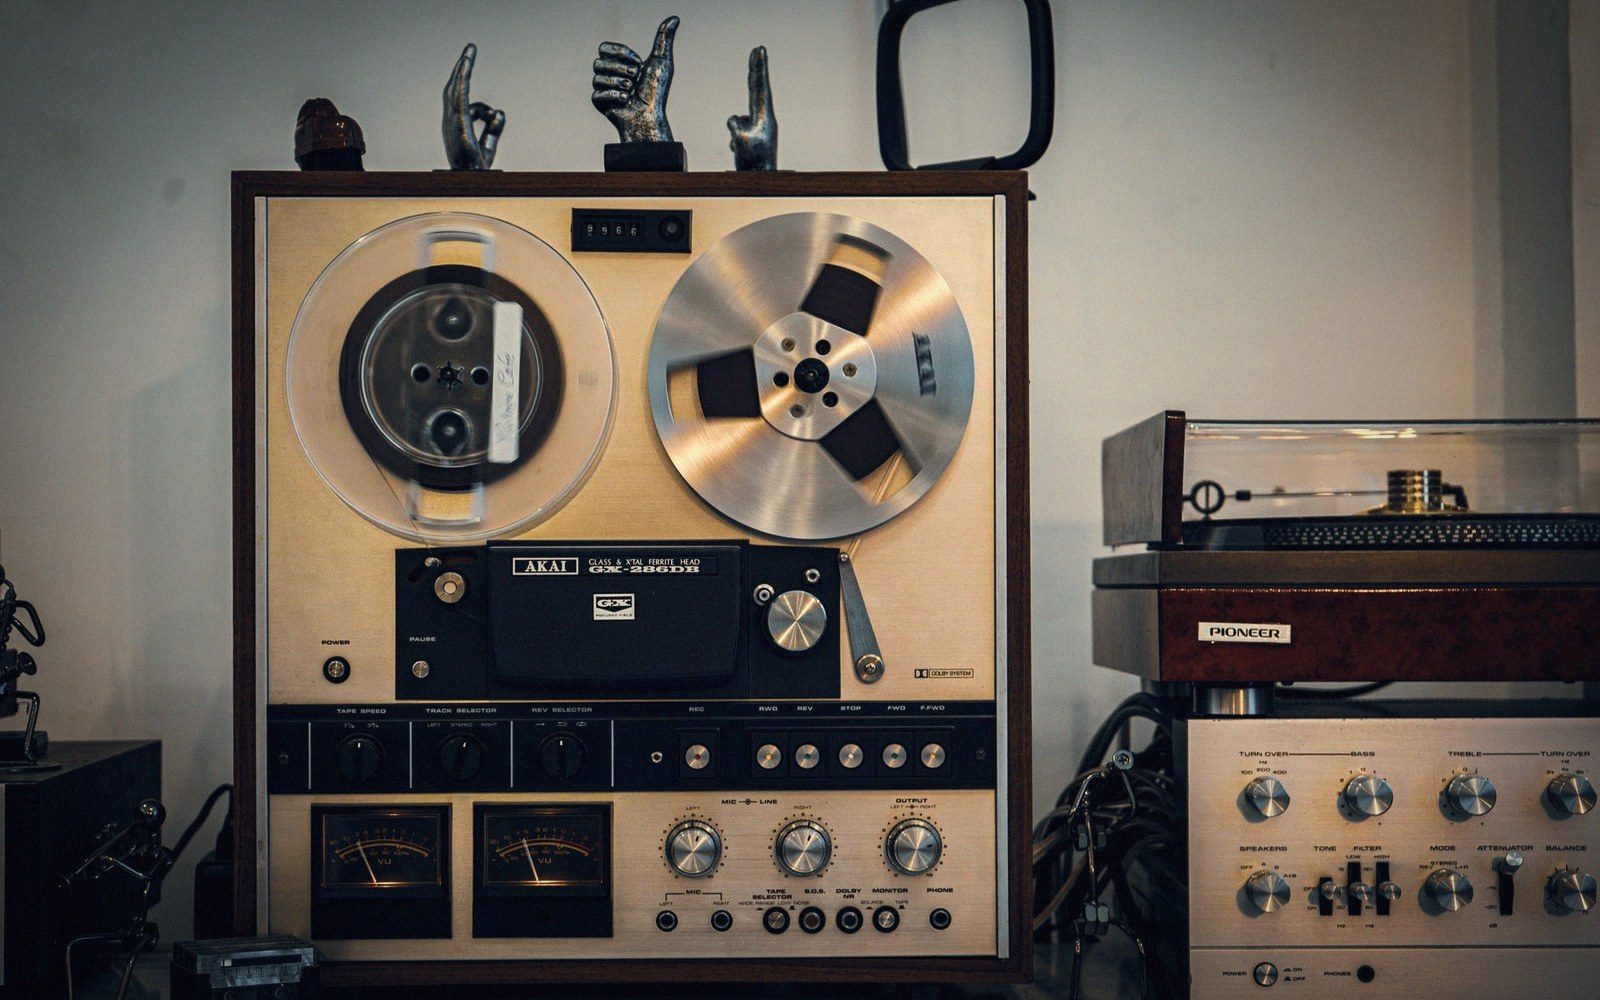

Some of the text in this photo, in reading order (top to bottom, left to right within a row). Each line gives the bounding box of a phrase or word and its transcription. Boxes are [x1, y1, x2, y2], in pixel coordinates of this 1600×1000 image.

[525, 560, 567, 572] AKAI
[588, 558, 612, 566] GLASS
[648, 558, 675, 566] FERRITE
[680, 558, 700, 566] HEAD
[1209, 627, 1280, 638] PIONEER
